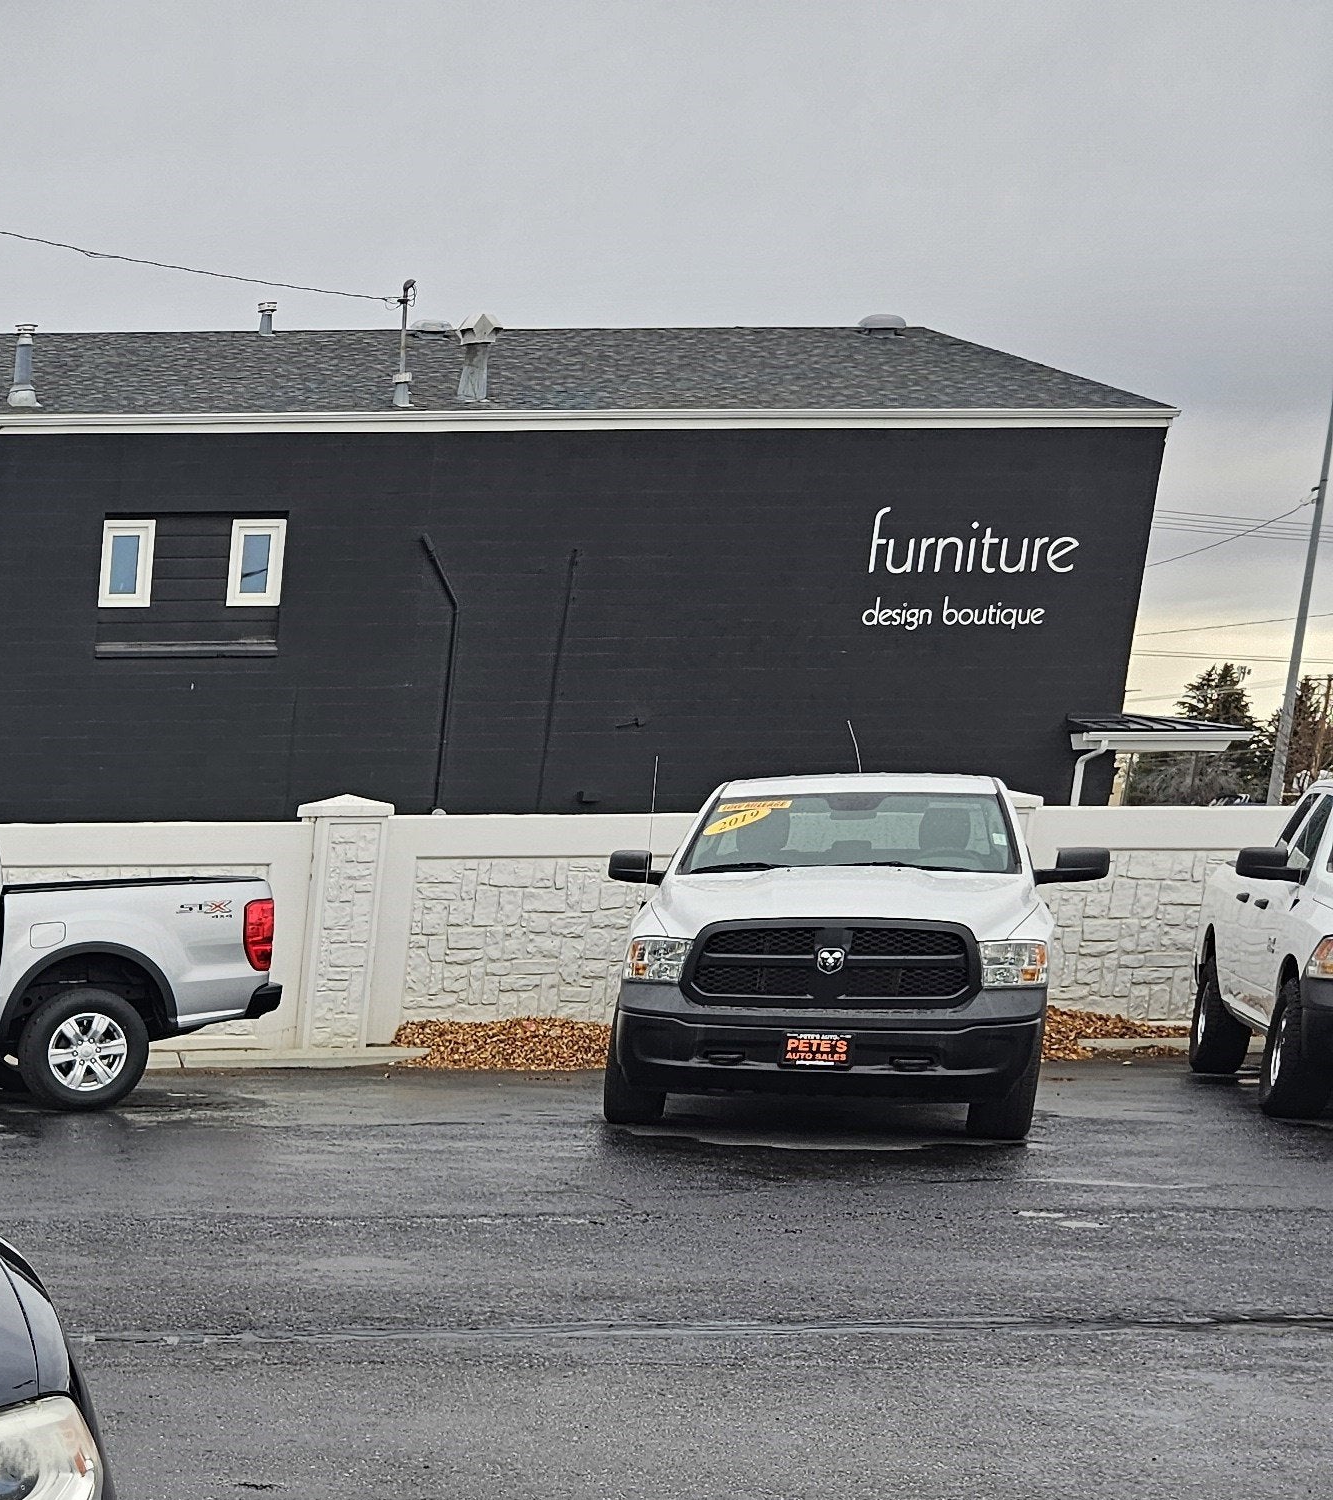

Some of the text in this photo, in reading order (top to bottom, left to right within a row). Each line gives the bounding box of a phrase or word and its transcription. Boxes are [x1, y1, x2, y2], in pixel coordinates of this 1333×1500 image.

[868, 506, 1080, 574] furniture
[861, 595, 1045, 631] design boutique
[719, 810, 760, 832] 2019
[785, 1052, 847, 1061] AUTO SALES
[786, 1038, 848, 1053] PETE'S
